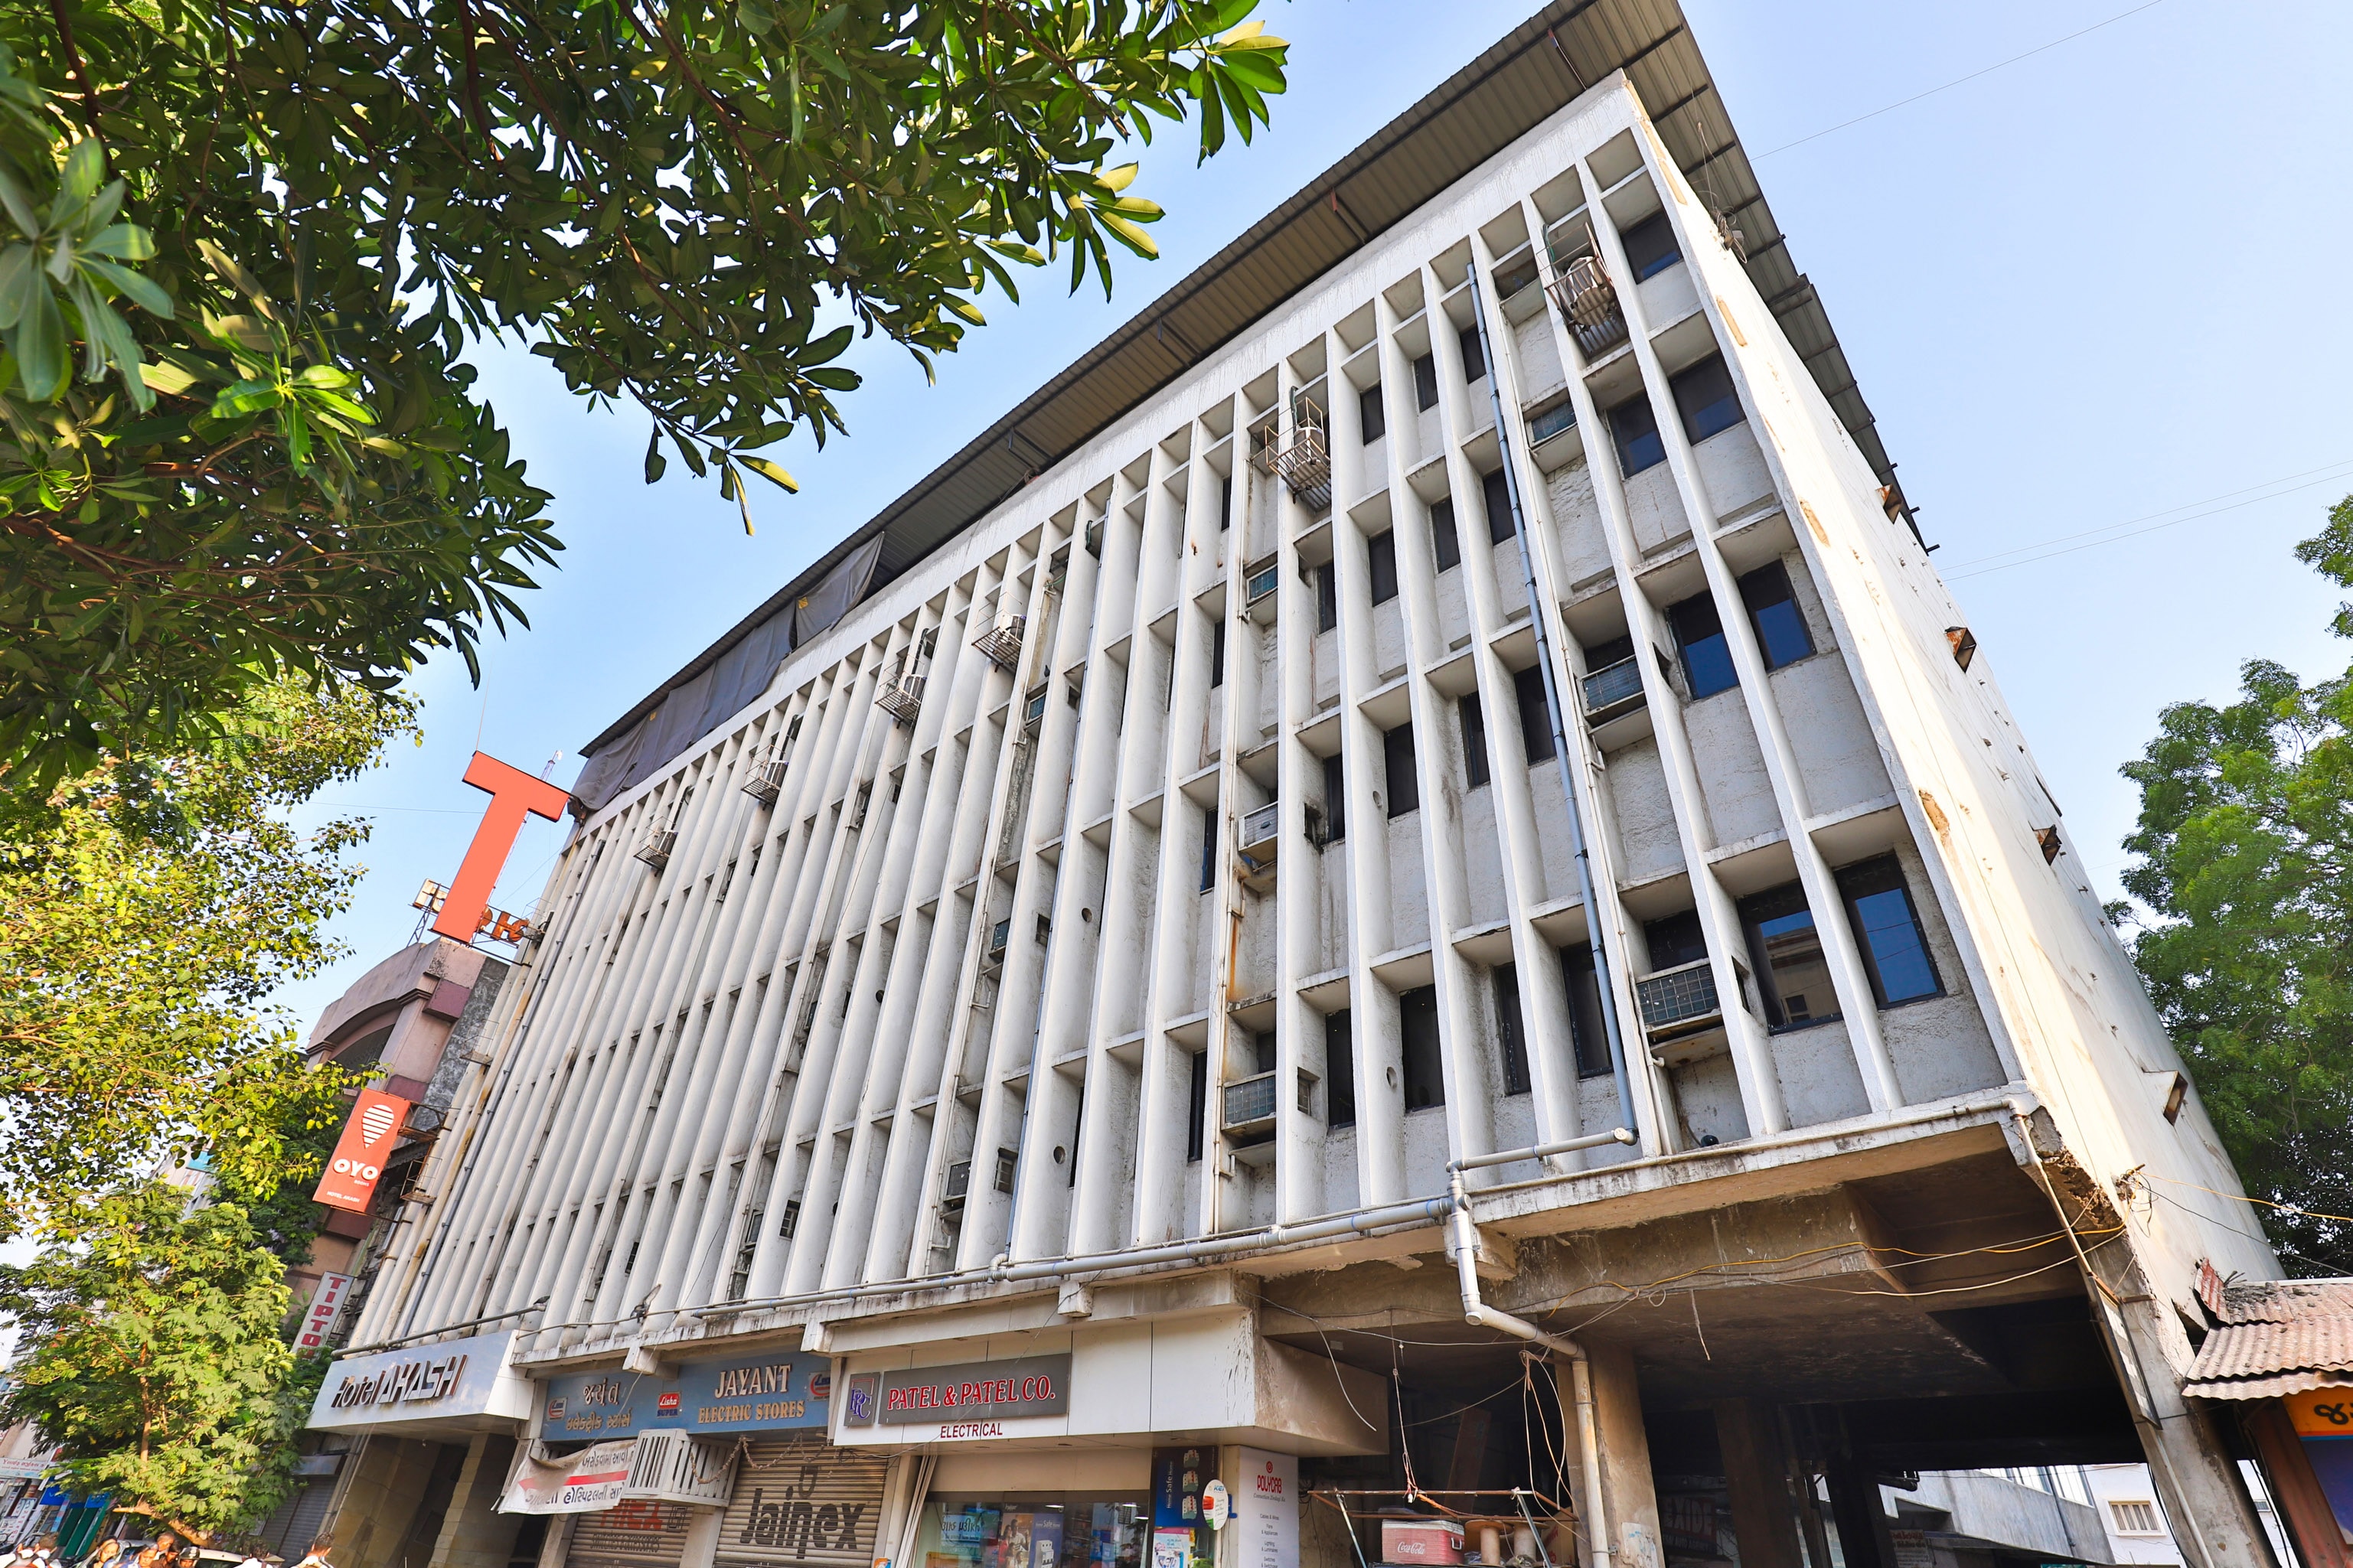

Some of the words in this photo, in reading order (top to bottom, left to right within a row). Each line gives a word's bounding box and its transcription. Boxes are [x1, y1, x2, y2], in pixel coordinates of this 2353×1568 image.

[333, 1159, 378, 1180] OYO
[327, 1191, 343, 1199] HOTEL
[343, 1195, 360, 1203] AKASH
[331, 1371, 386, 1407] Hotel
[378, 1354, 468, 1403] AKASH
[715, 1364, 791, 1399] JAYANT
[887, 1385, 941, 1410] PATEL
[943, 1384, 957, 1407] &
[960, 1378, 1020, 1404] PATEL
[1022, 1375, 1056, 1401] CO.
[698, 1403, 752, 1423] ELECTRIC
[756, 1400, 804, 1421] STORES
[2313, 1403, 2353, 1426] જ
[940, 1423, 1003, 1439] ELECTRICAL
[1257, 1475, 1282, 1494] POLYCAB
